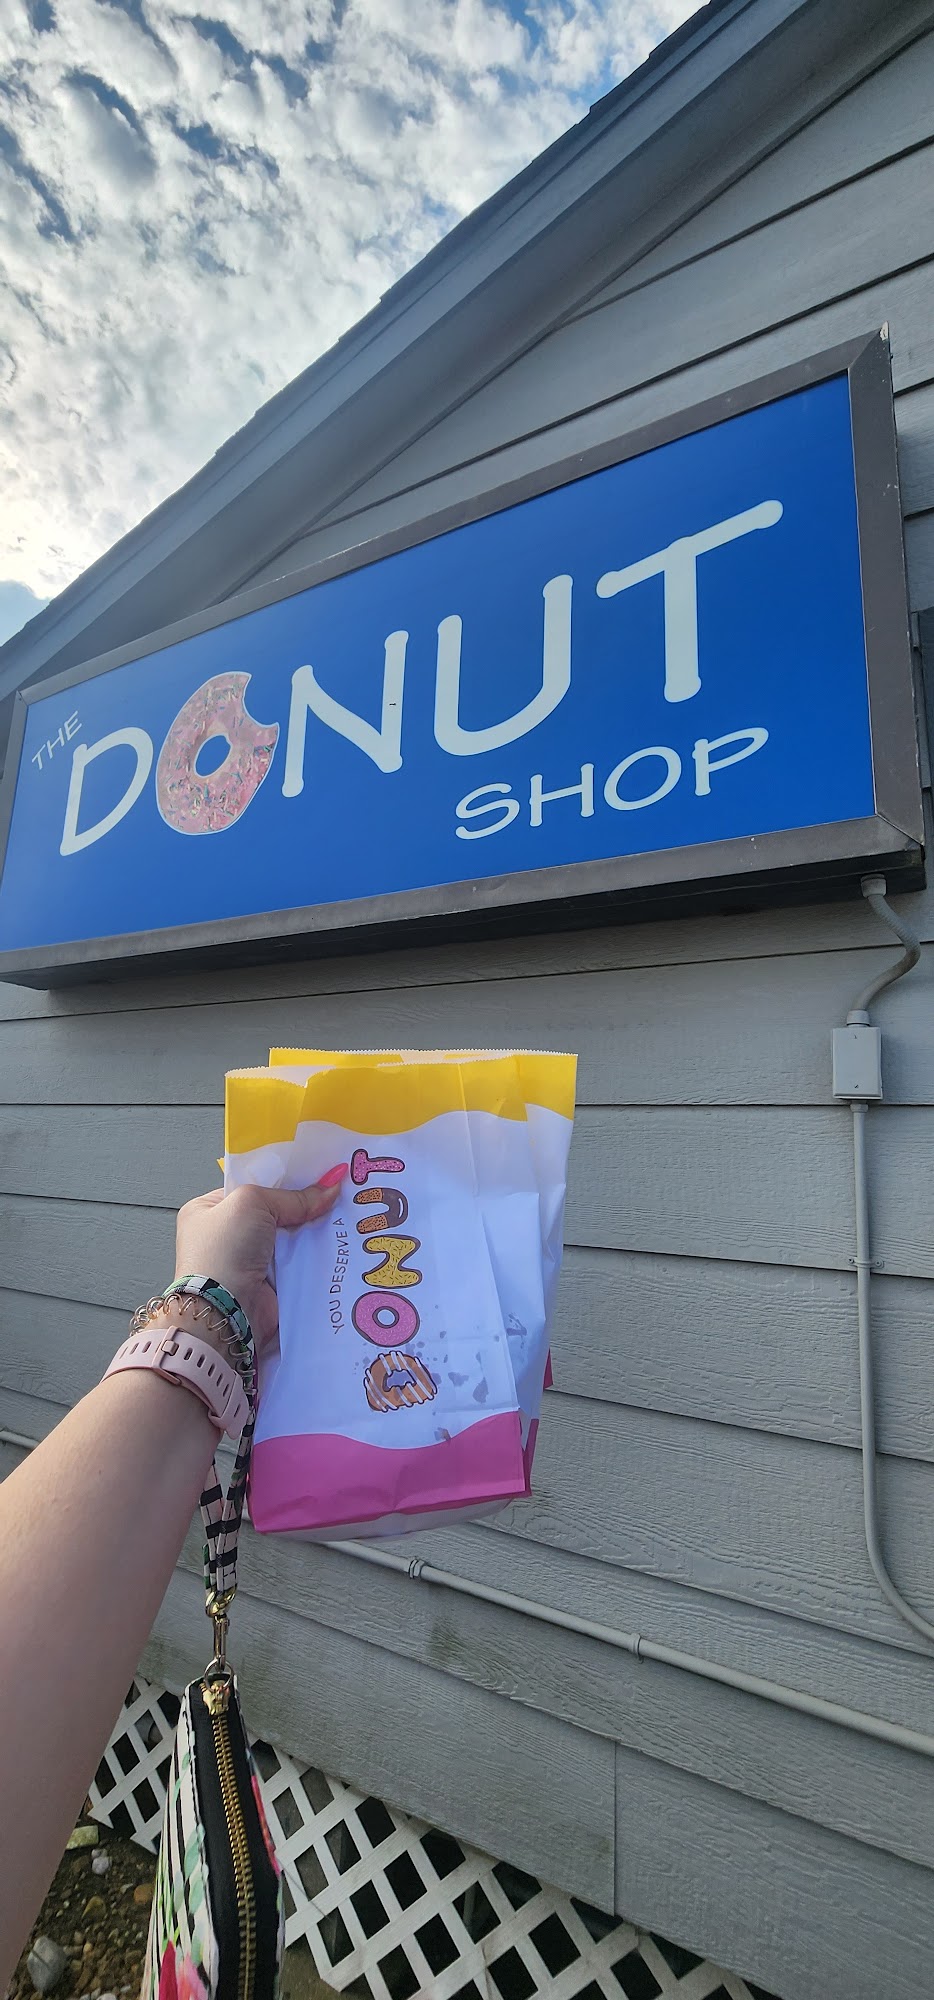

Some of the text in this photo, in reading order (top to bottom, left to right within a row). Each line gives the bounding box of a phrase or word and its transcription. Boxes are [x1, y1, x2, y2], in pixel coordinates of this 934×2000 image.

[60, 499, 784, 857] DONUT
[31, 710, 83, 771] THE
[454, 727, 770, 841] SHOP
[328, 1217, 350, 1335] YOU DESERVE A
[350, 1148, 438, 1413] DONUT
